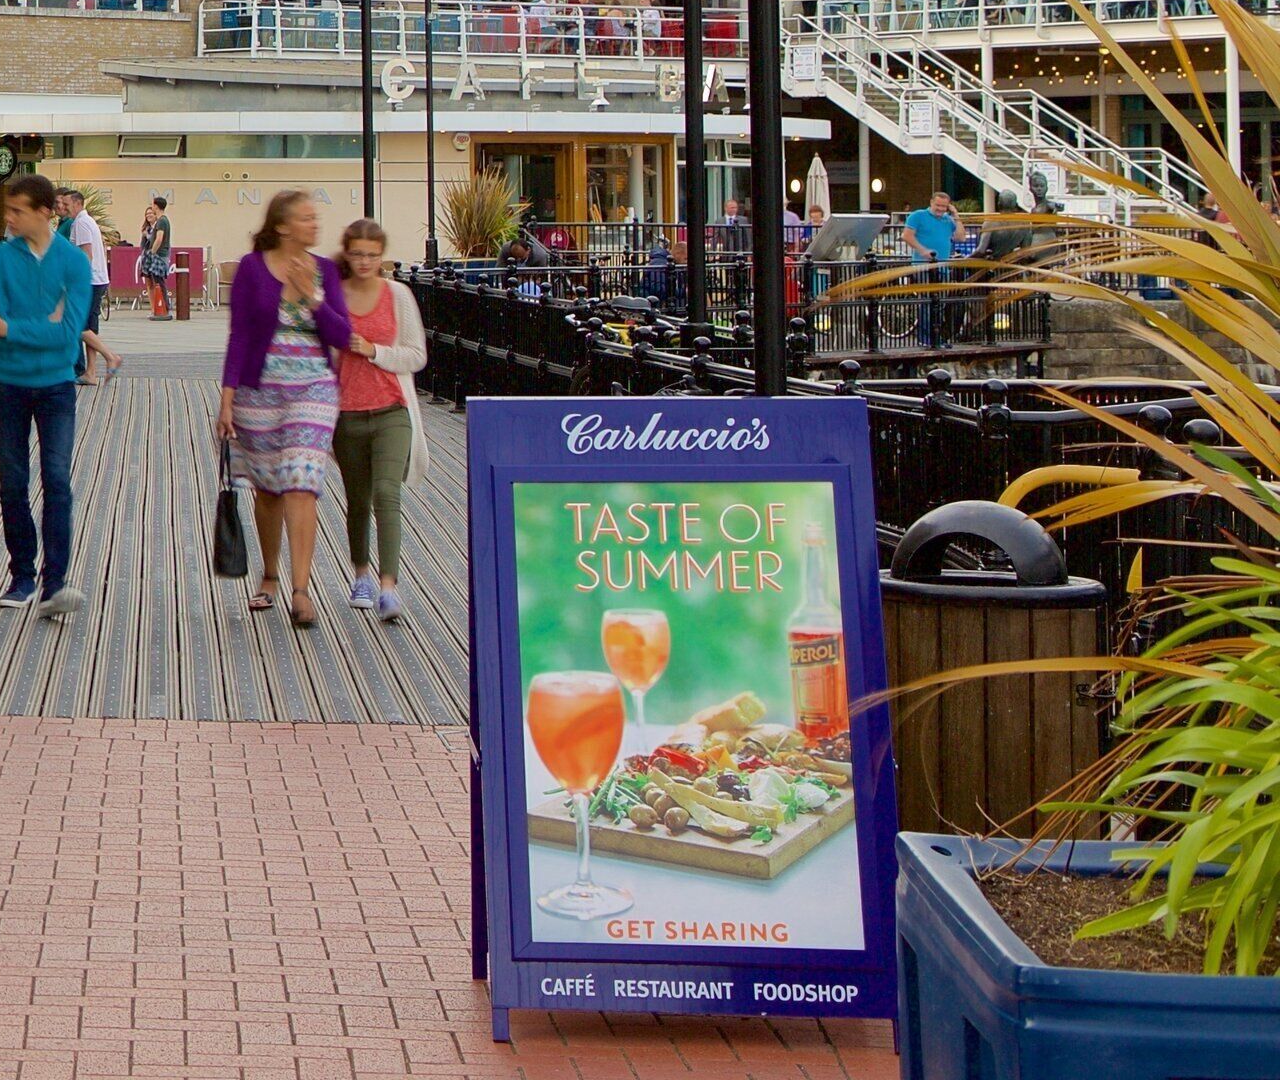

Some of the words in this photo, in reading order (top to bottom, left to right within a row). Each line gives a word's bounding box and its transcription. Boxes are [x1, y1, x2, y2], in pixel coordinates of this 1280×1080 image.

[560, 412, 771, 455] Carluccio's
[564, 502, 702, 545] TASTE
[719, 502, 788, 544] OF
[574, 550, 785, 593] SUMMER
[606, 918, 658, 940] GET
[665, 919, 789, 943] SHARING
[613, 978, 734, 1001] RESTAURANT
[753, 982, 859, 1004] FOODSHOP
